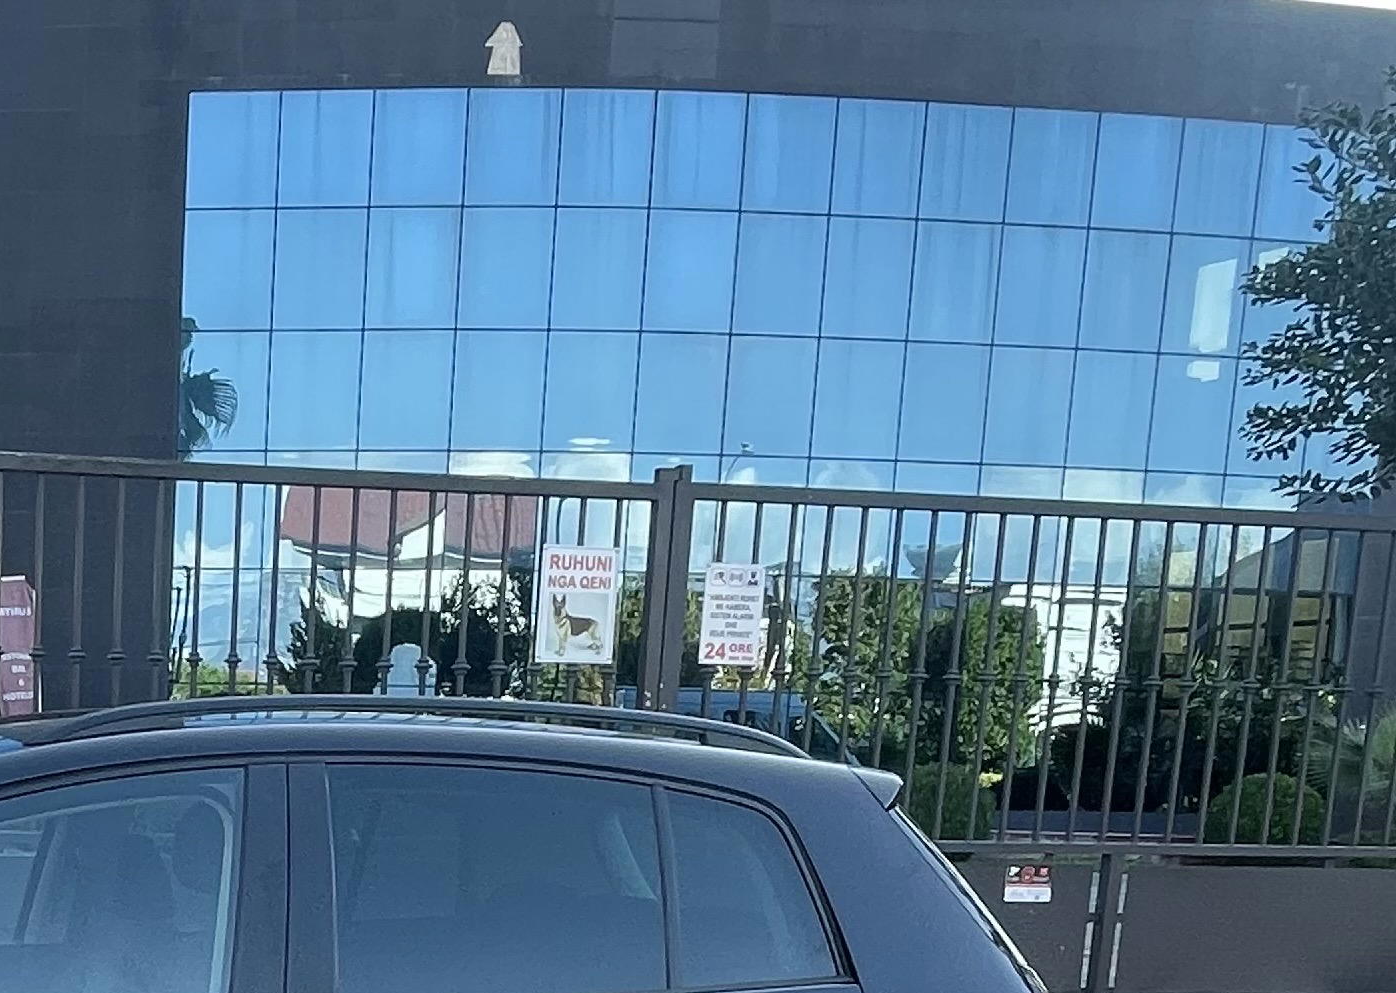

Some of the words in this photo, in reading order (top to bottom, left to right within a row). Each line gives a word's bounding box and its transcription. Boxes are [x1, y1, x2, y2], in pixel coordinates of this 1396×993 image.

[549, 554, 613, 572] RUHUNI
[548, 575, 577, 589] NGA
[579, 576, 612, 590] QENI
[704, 641, 726, 660] 24
[728, 643, 753, 654] ORE
